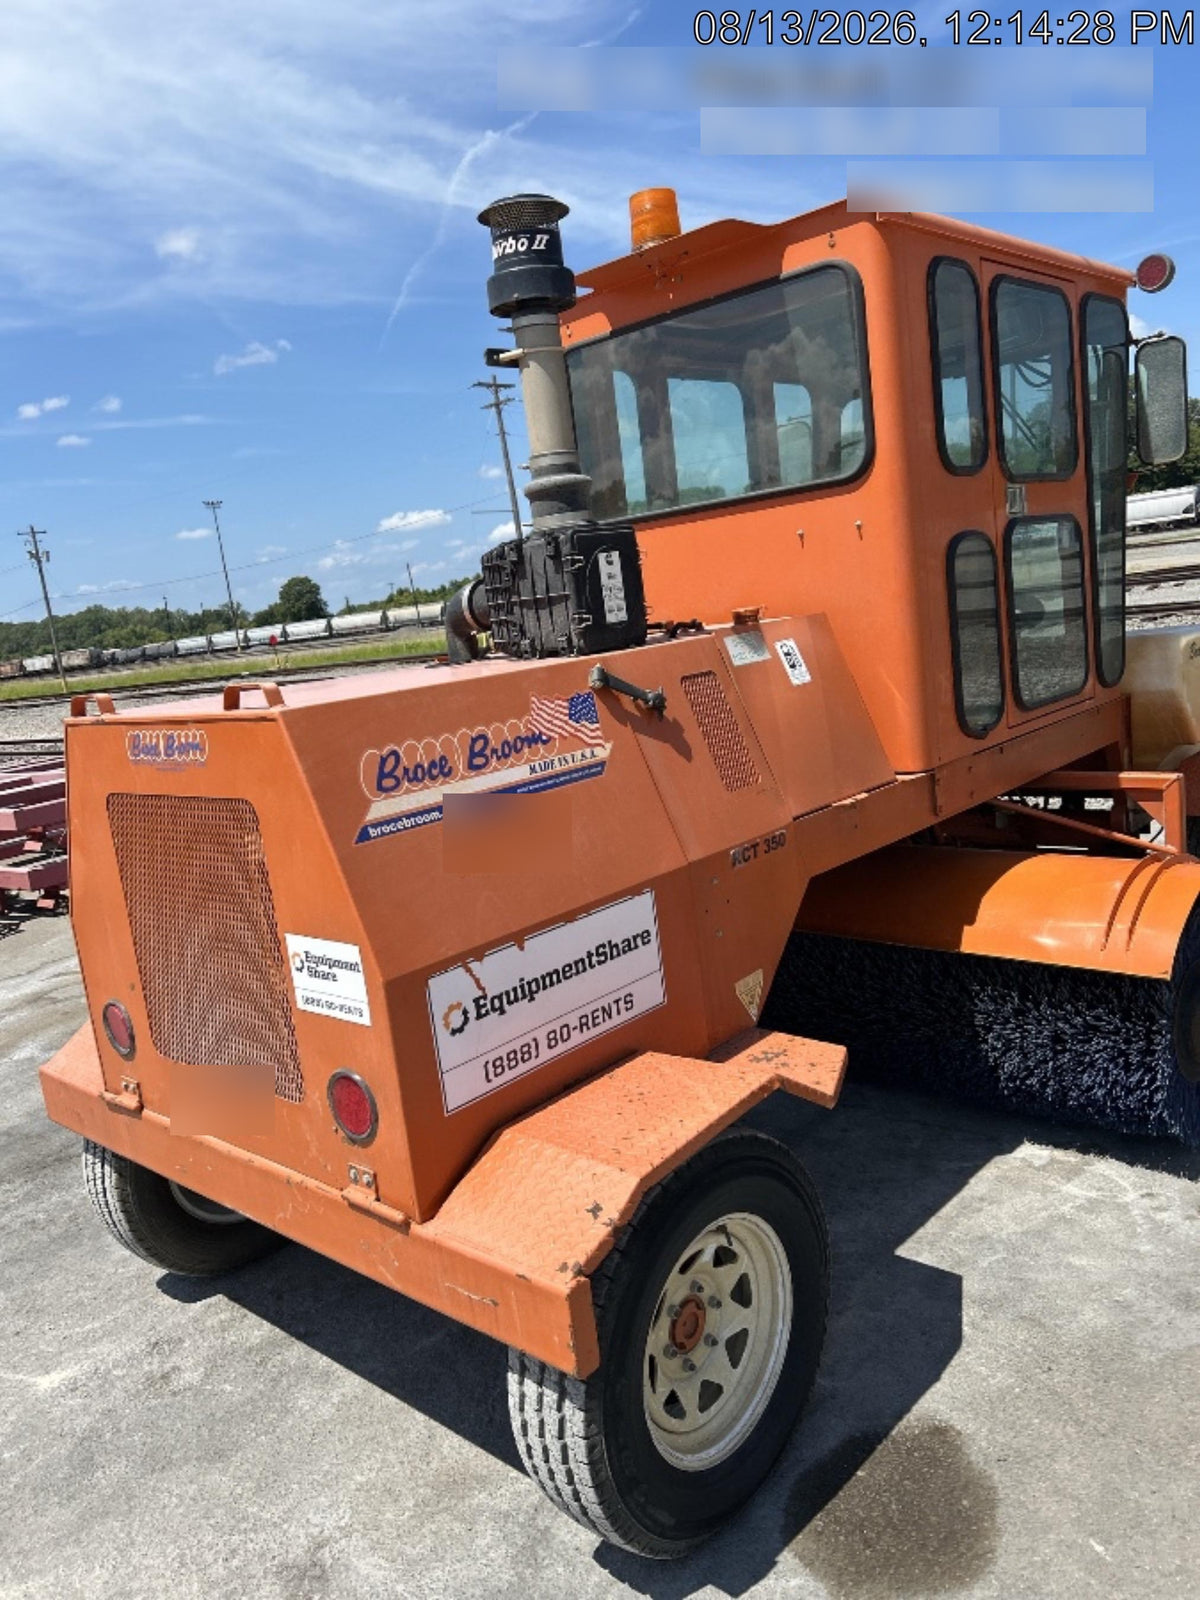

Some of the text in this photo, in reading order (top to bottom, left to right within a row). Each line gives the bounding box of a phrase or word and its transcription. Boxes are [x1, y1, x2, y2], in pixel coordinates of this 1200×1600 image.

[375, 732, 551, 793] Broce Broom
[303, 950, 362, 974] Equipment
[306, 964, 339, 983] Share
[472, 928, 652, 1021] EquipmentShare
[482, 992, 635, 1083] (888) 80-RENTS
